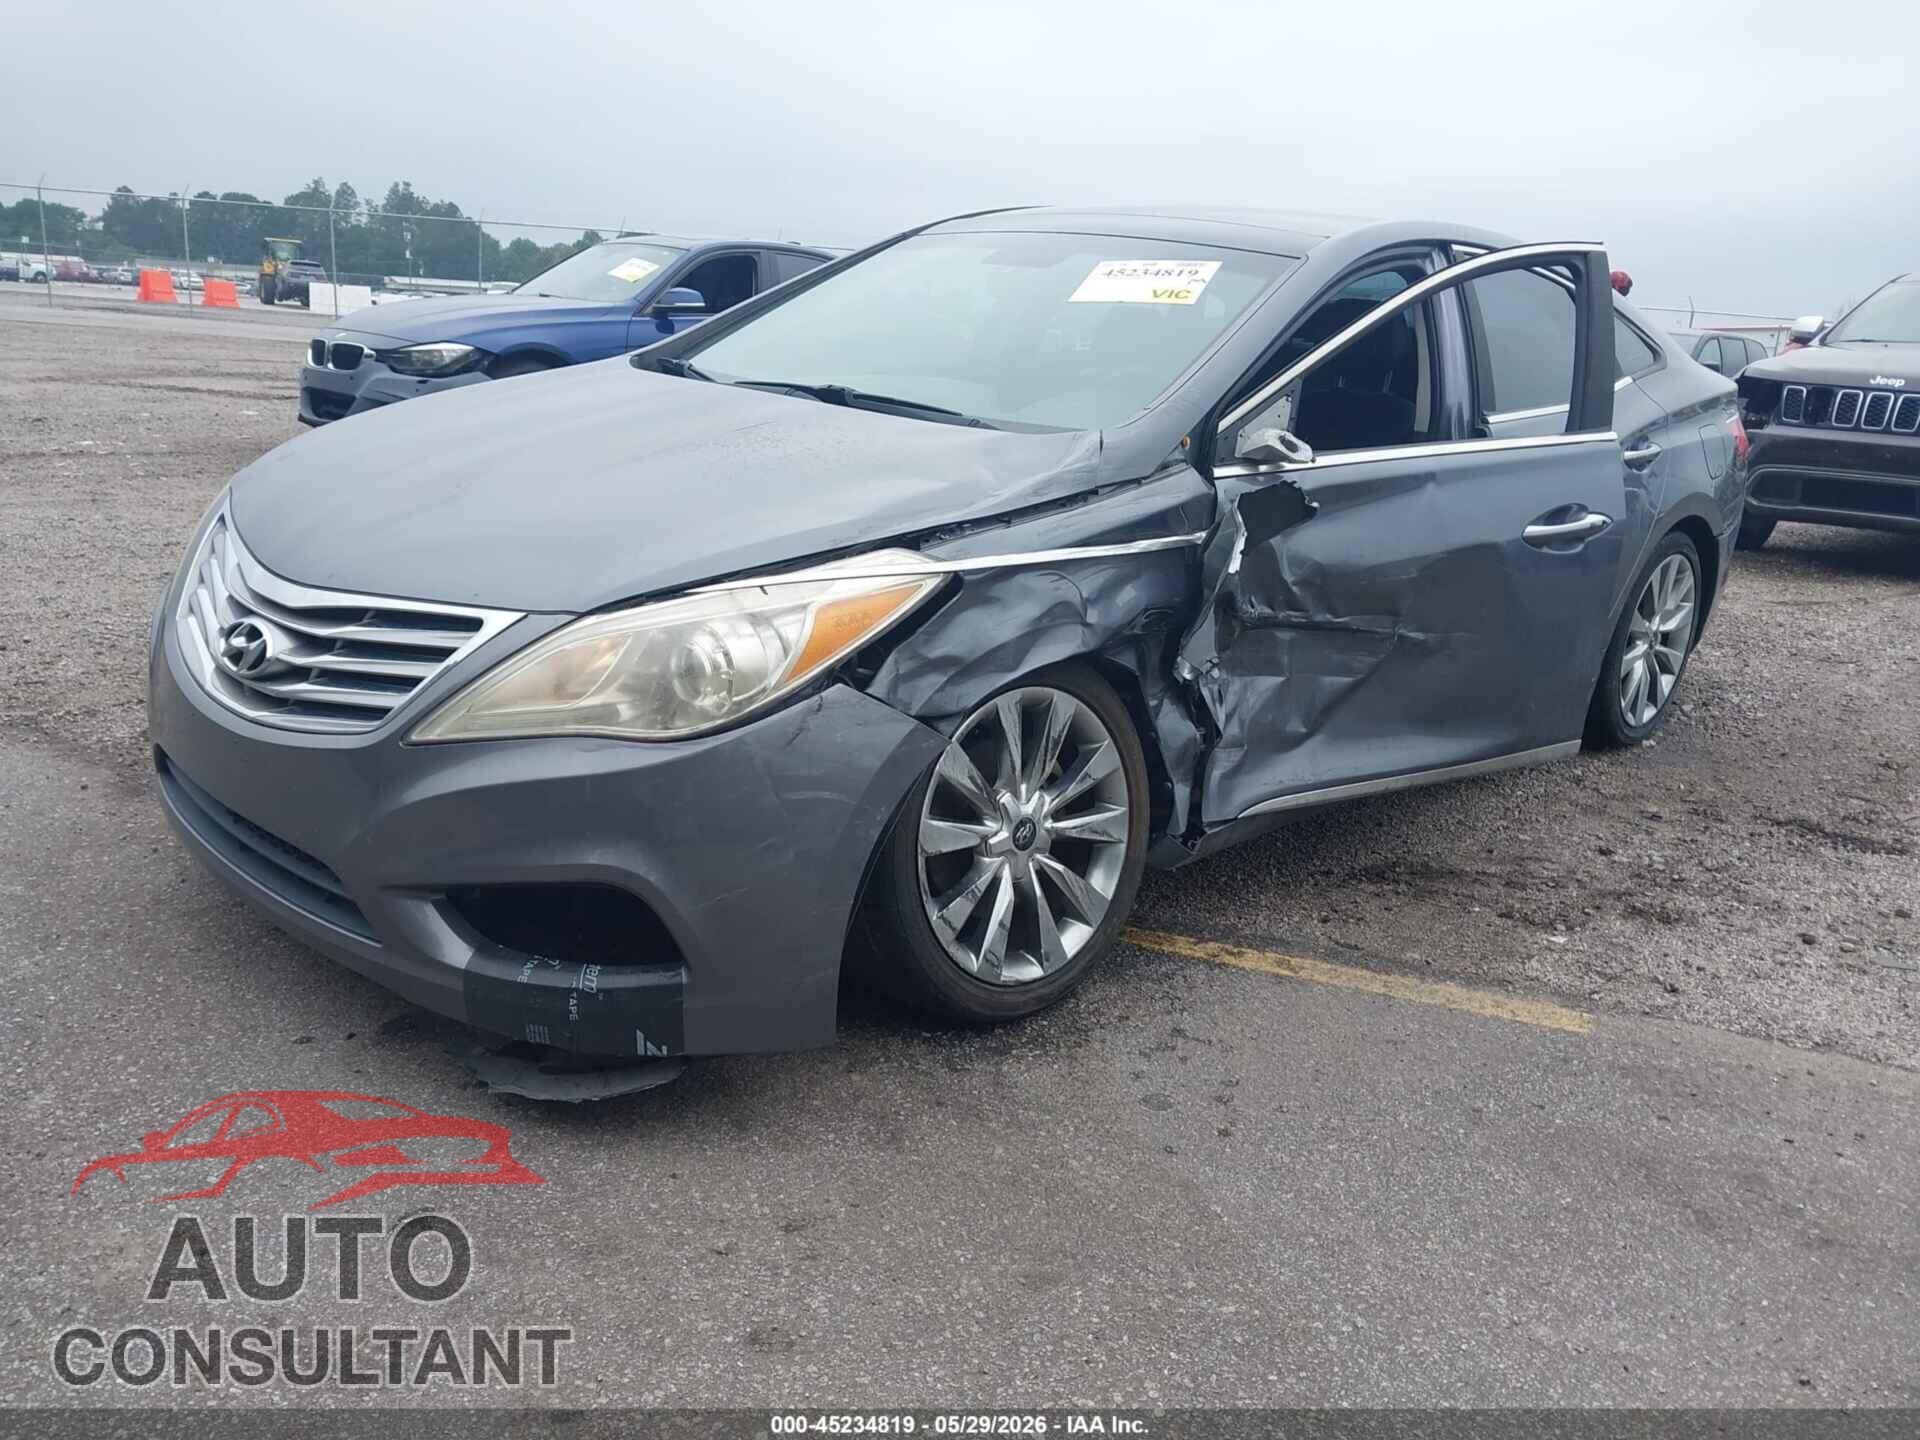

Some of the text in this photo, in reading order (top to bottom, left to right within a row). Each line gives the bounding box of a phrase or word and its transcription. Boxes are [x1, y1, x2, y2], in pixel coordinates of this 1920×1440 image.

[1151, 288, 1192, 299] VIC
[1869, 376, 1906, 387] Jeep
[568, 992, 579, 1021] TAPE
